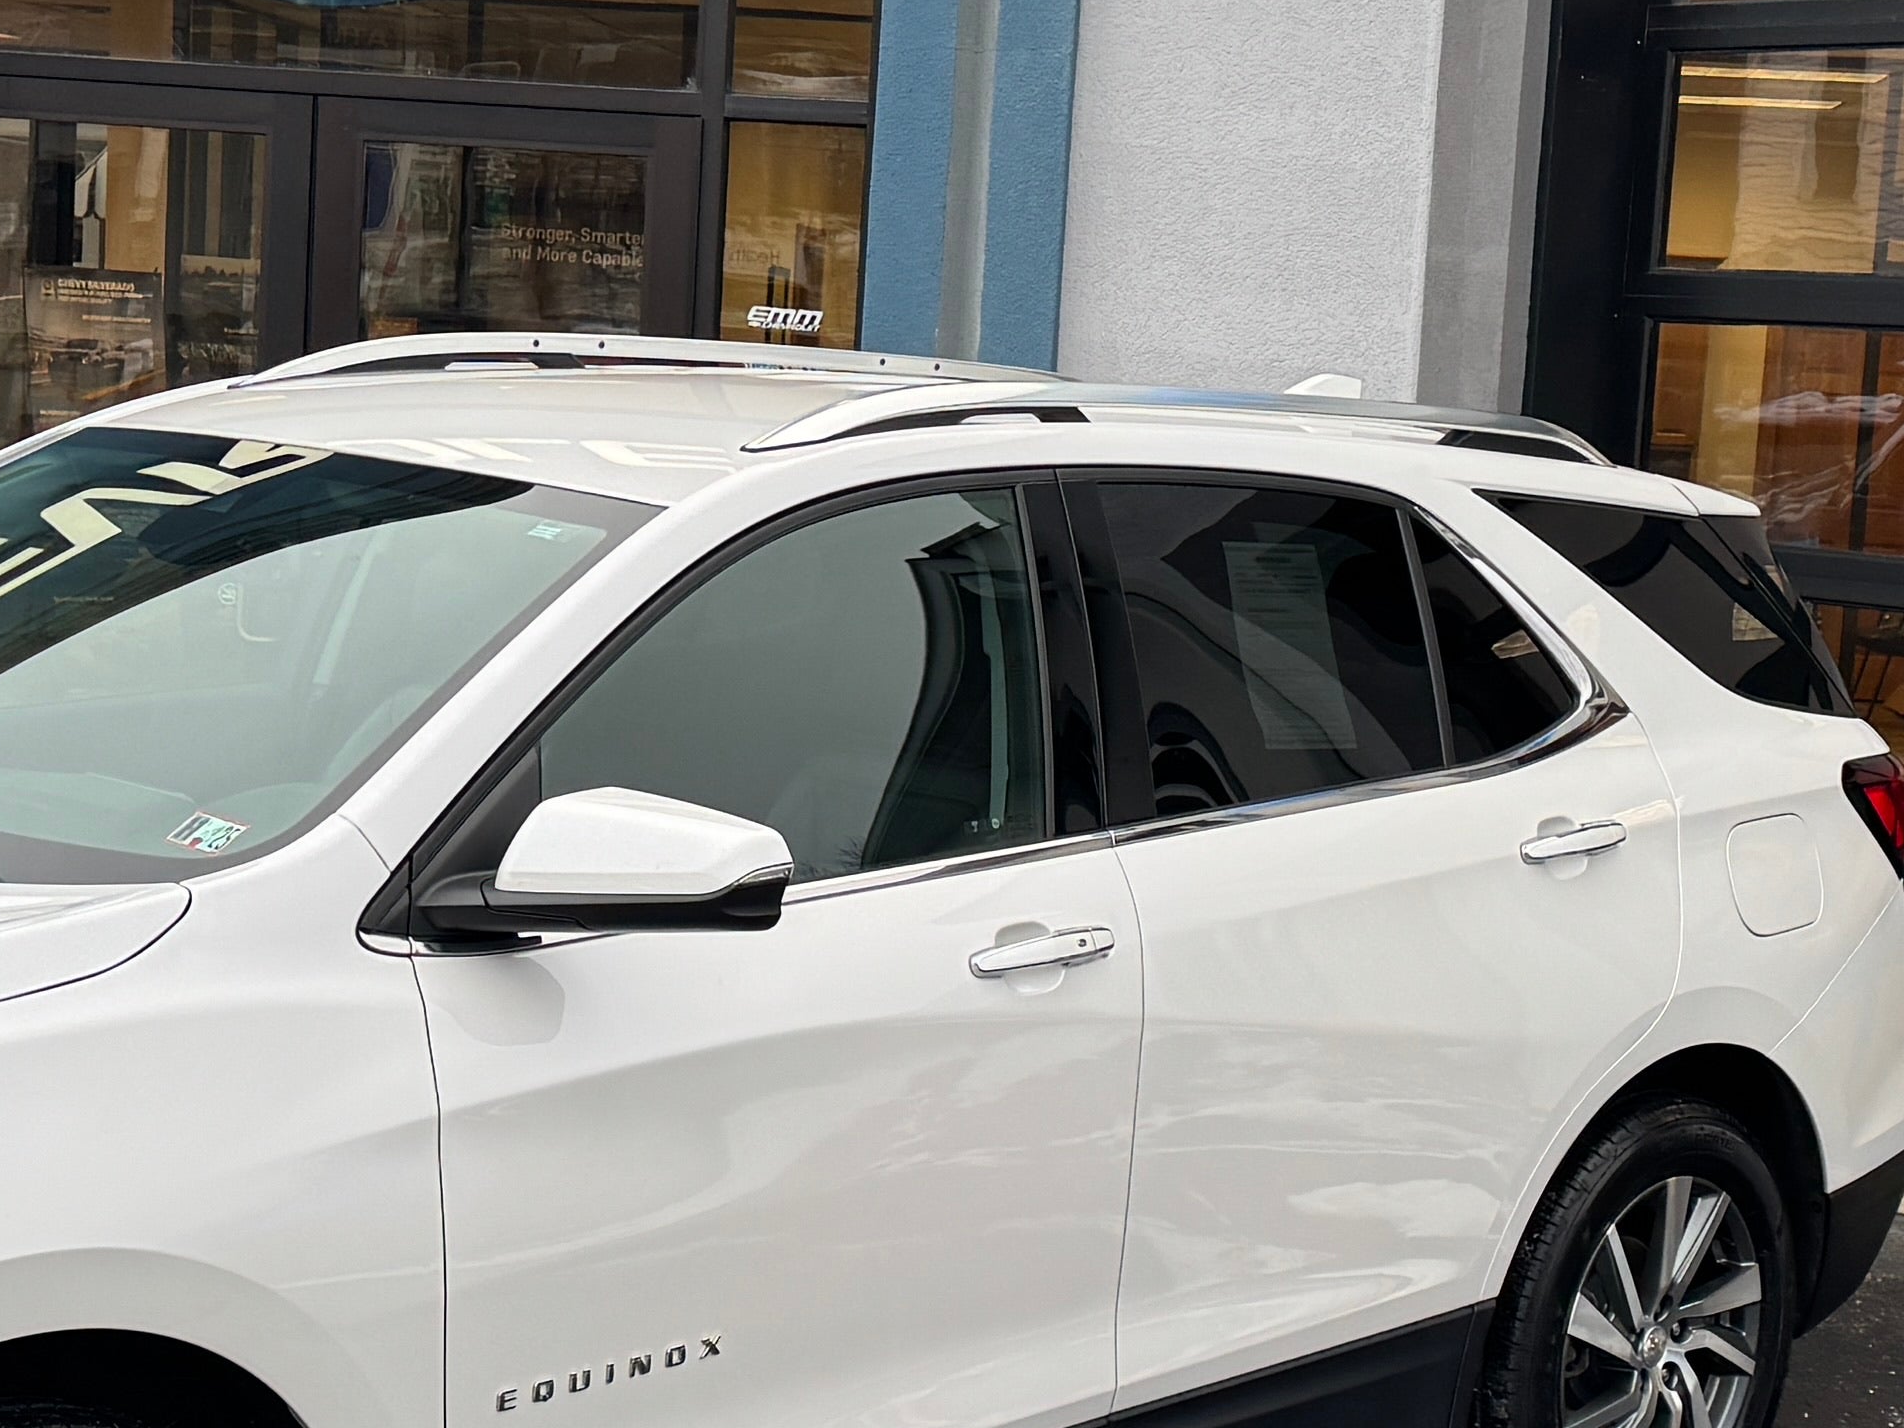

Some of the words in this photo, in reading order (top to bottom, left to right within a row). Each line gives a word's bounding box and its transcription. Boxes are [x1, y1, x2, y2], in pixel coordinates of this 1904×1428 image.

[500, 223, 576, 244] Stronger,
[502, 245, 532, 260] and
[537, 246, 577, 263] More
[496, 1335, 722, 1412] EQUINOX
